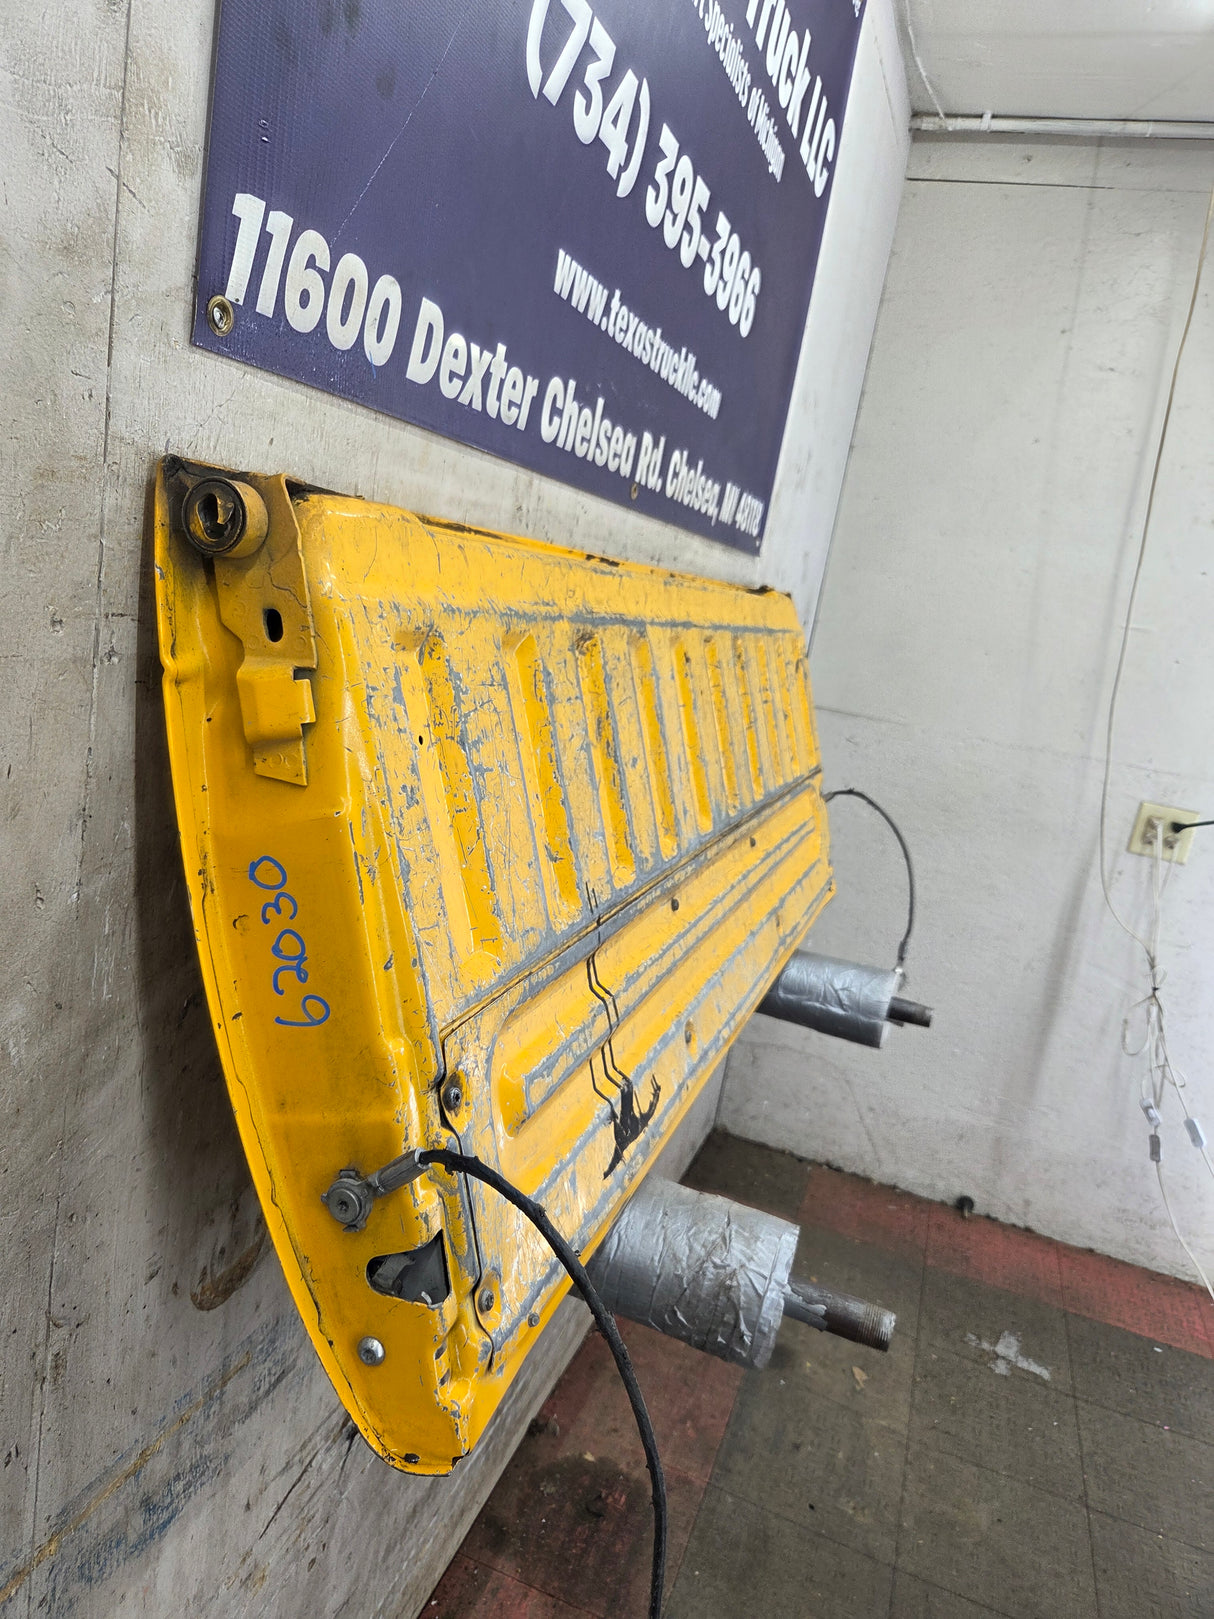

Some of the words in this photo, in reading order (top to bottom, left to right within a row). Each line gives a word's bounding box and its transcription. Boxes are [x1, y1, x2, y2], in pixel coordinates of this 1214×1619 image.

[526, 0, 650, 197] (734)
[646, 123, 762, 338] 395-3966
[747, 87, 763, 128] of
[799, 75, 836, 198] LLC
[224, 192, 402, 367] 11600
[405, 296, 539, 431] Dexter
[540, 376, 637, 478] Chelsea
[635, 430, 666, 493] Rd.
[665, 448, 721, 527] Chelsea,
[554, 248, 723, 420] www.texastruckllc.com
[248, 855, 331, 1027] 62030
